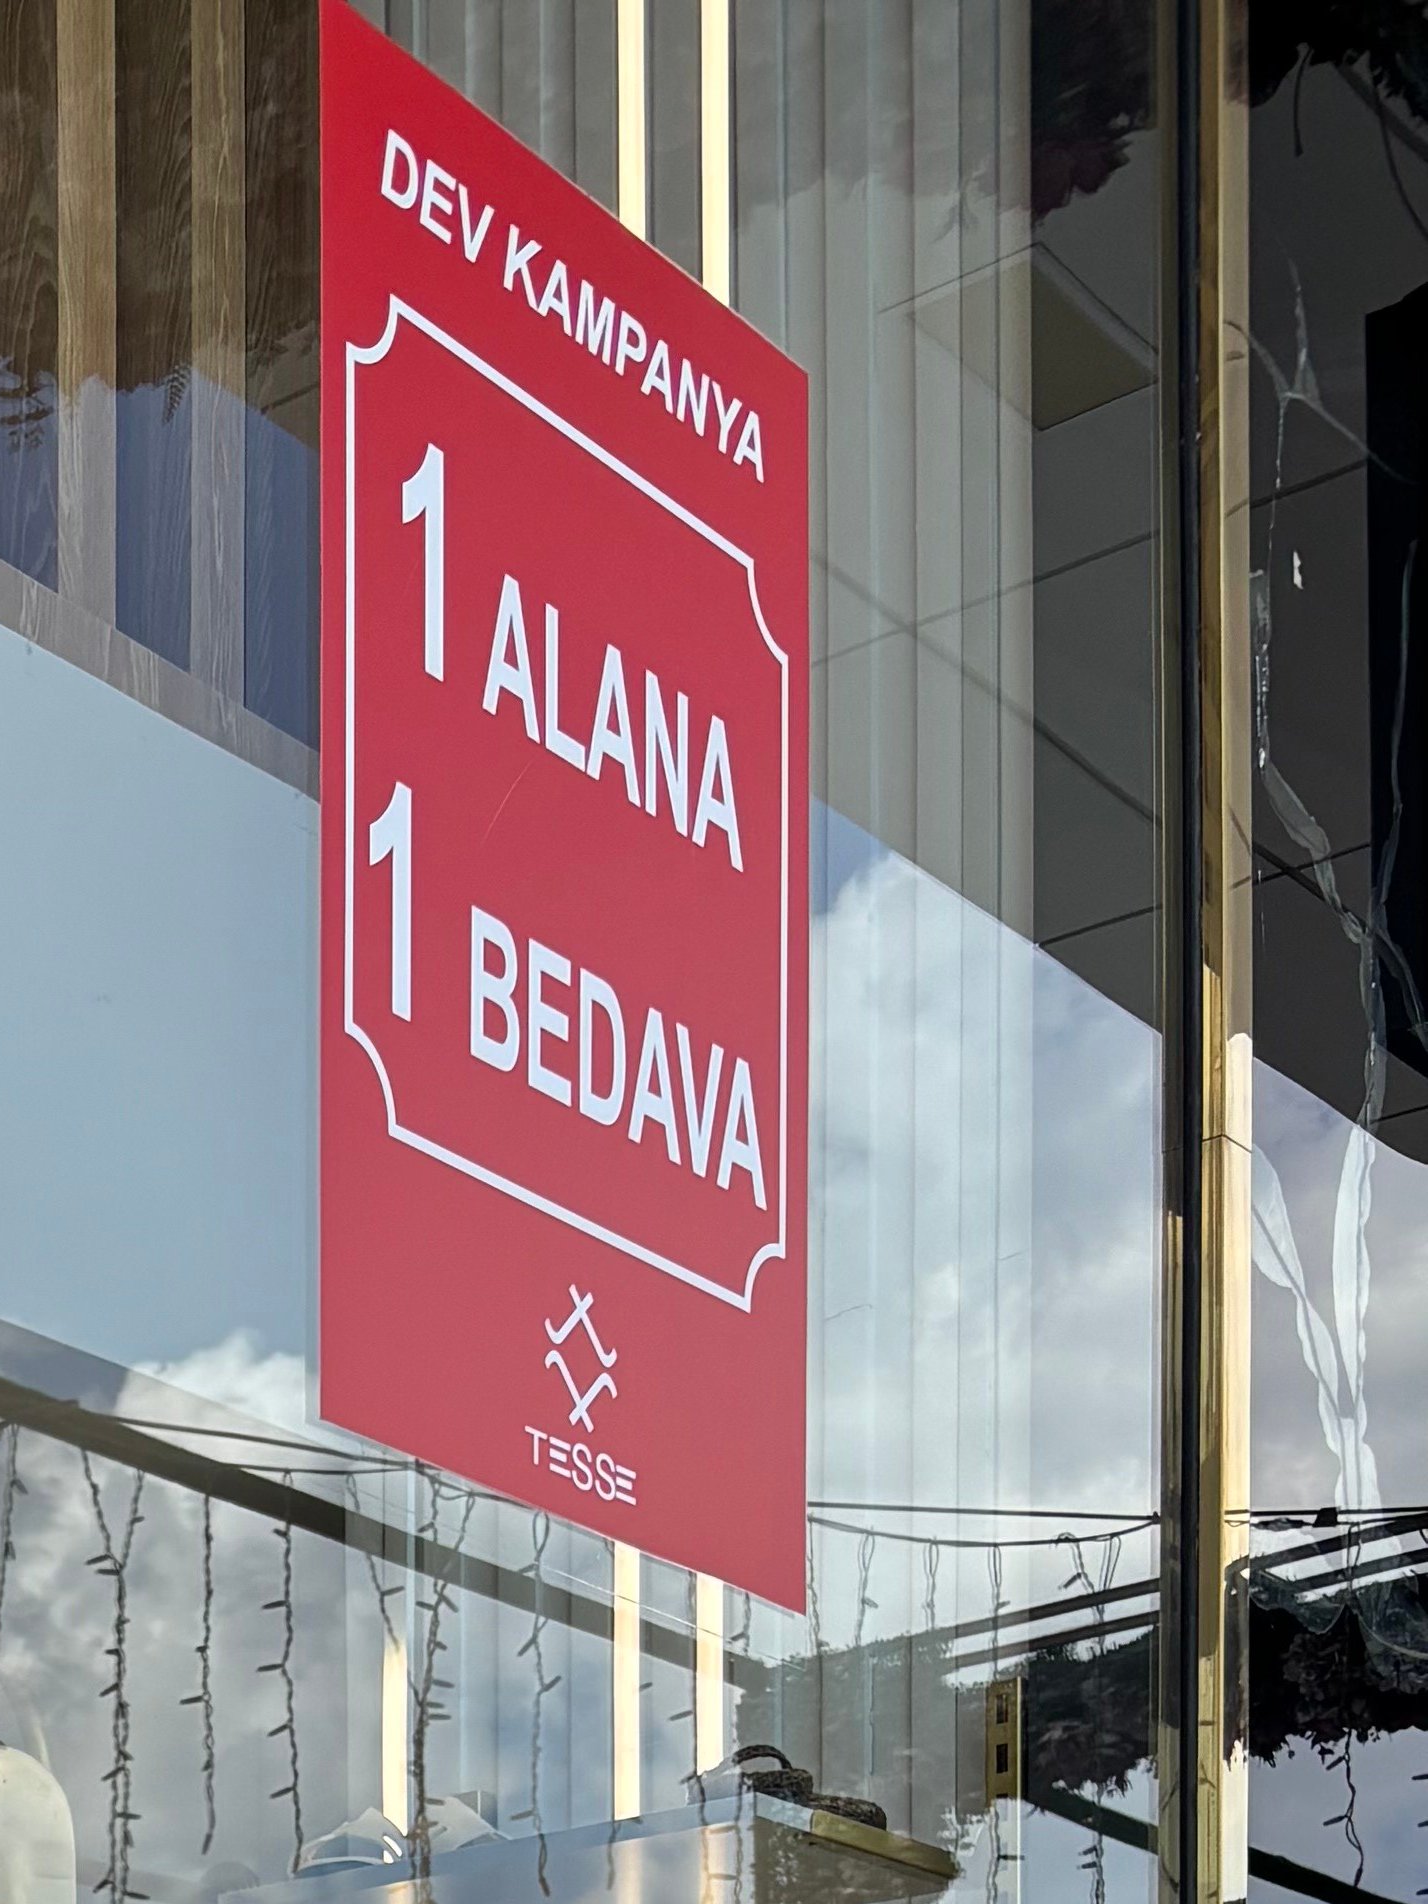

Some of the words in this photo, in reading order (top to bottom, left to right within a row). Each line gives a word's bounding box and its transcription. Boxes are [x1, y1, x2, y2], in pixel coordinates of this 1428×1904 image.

[380, 129, 495, 263] DEV
[503, 224, 765, 483] KAMPANYA
[402, 442, 445, 682] 1
[482, 573, 744, 873] ALANA
[369, 781, 412, 1022] 1
[470, 905, 768, 1211] BEDAVA
[524, 1425, 637, 1506] TESSE
